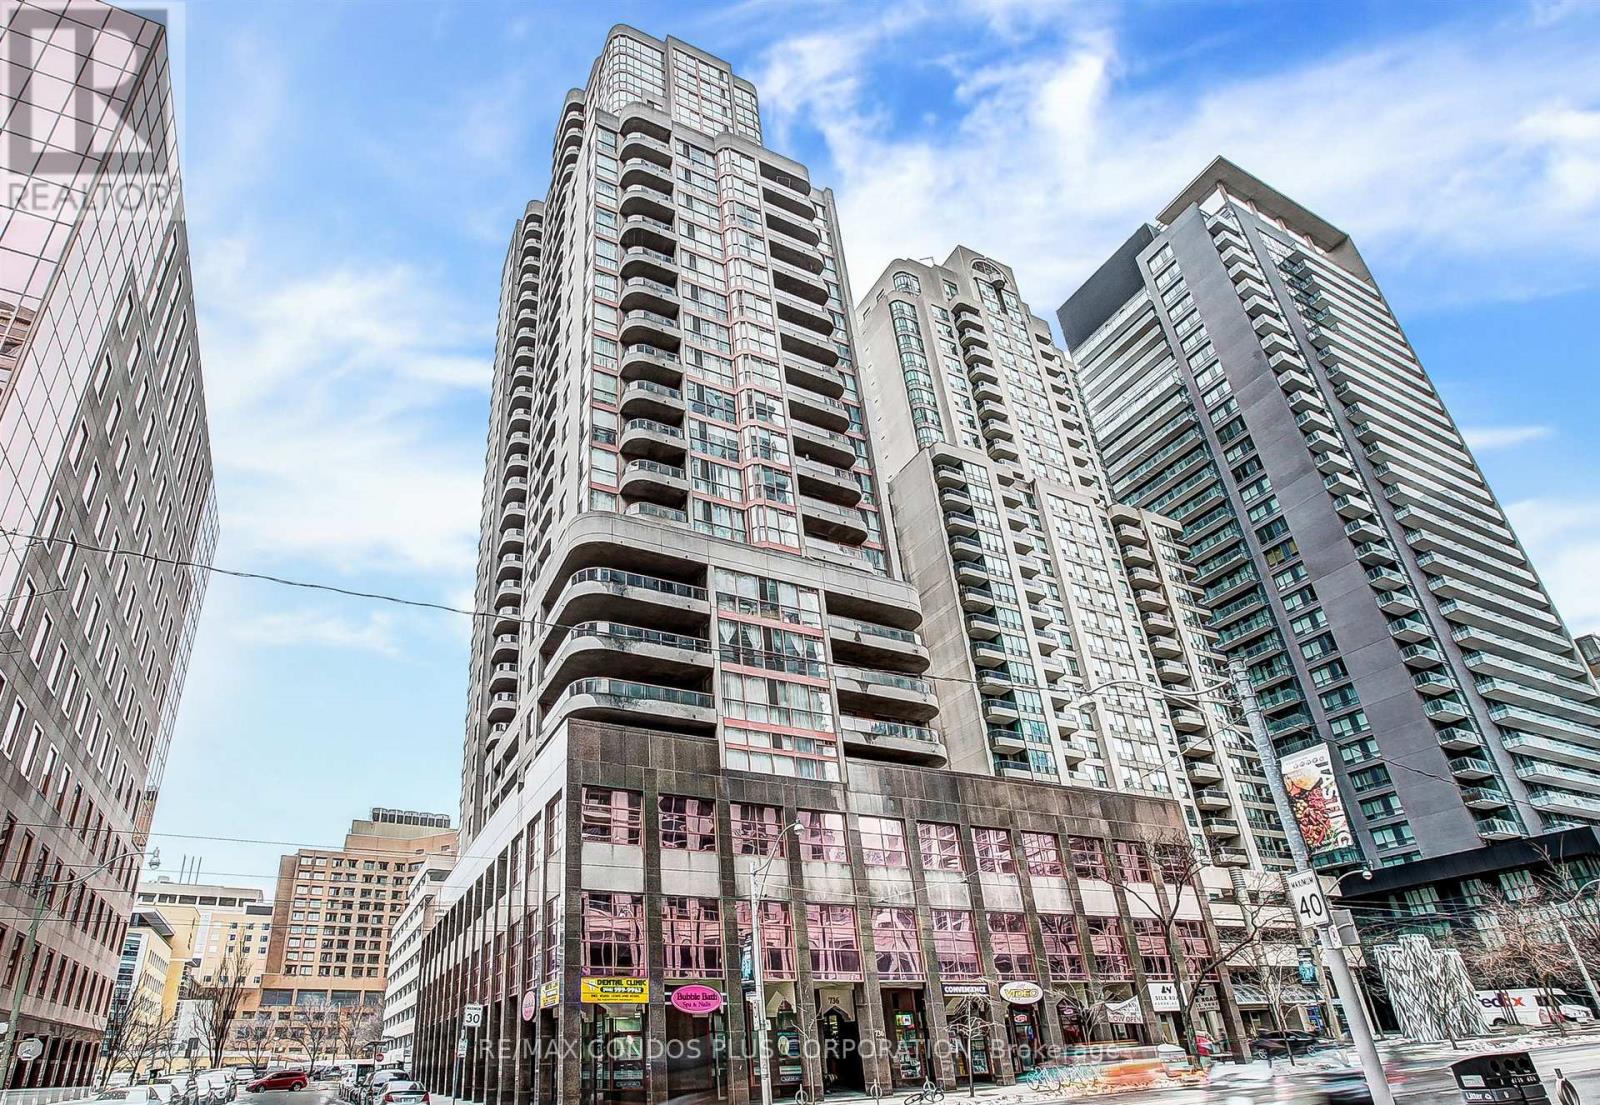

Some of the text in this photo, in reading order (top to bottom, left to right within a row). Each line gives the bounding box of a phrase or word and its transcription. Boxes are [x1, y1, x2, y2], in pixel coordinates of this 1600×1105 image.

[1314, 762, 1354, 849] TASTING
[1290, 876, 1314, 888] MAXIMUM
[1299, 893, 1323, 919] 40
[677, 992, 718, 1001] Bubble Bath
[1004, 988, 1039, 999] VIDEO
[829, 996, 840, 1005] 736
[466, 1013, 481, 1024] 30
[1126, 1015, 1142, 1023] OPEN
